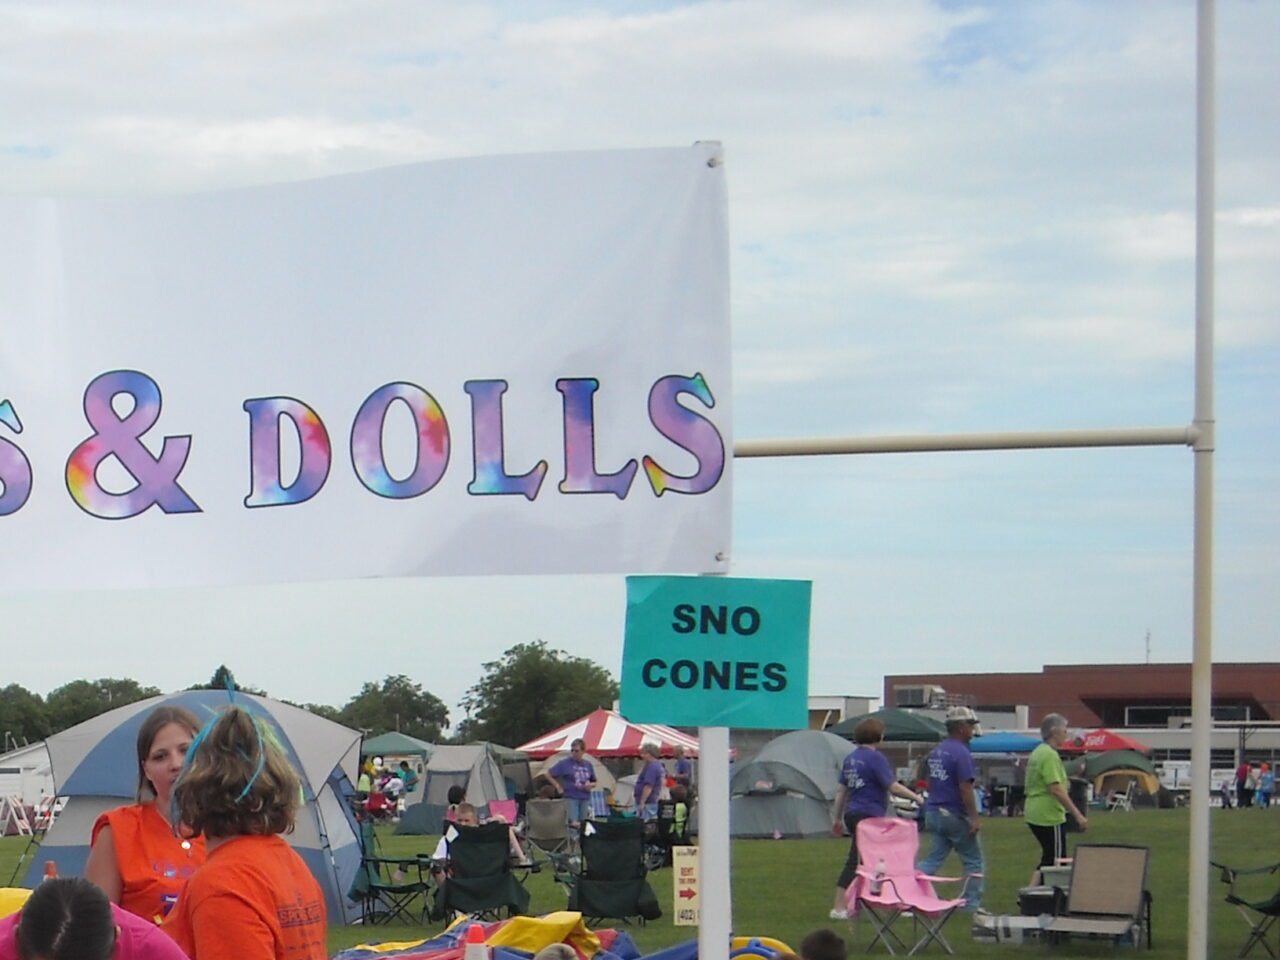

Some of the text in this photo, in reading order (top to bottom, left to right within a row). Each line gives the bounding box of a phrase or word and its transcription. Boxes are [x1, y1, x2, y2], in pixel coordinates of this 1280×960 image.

[64, 369, 204, 520] &
[242, 372, 726, 508] DOLLS
[671, 603, 761, 636] SNO
[641, 658, 788, 693] CONES
